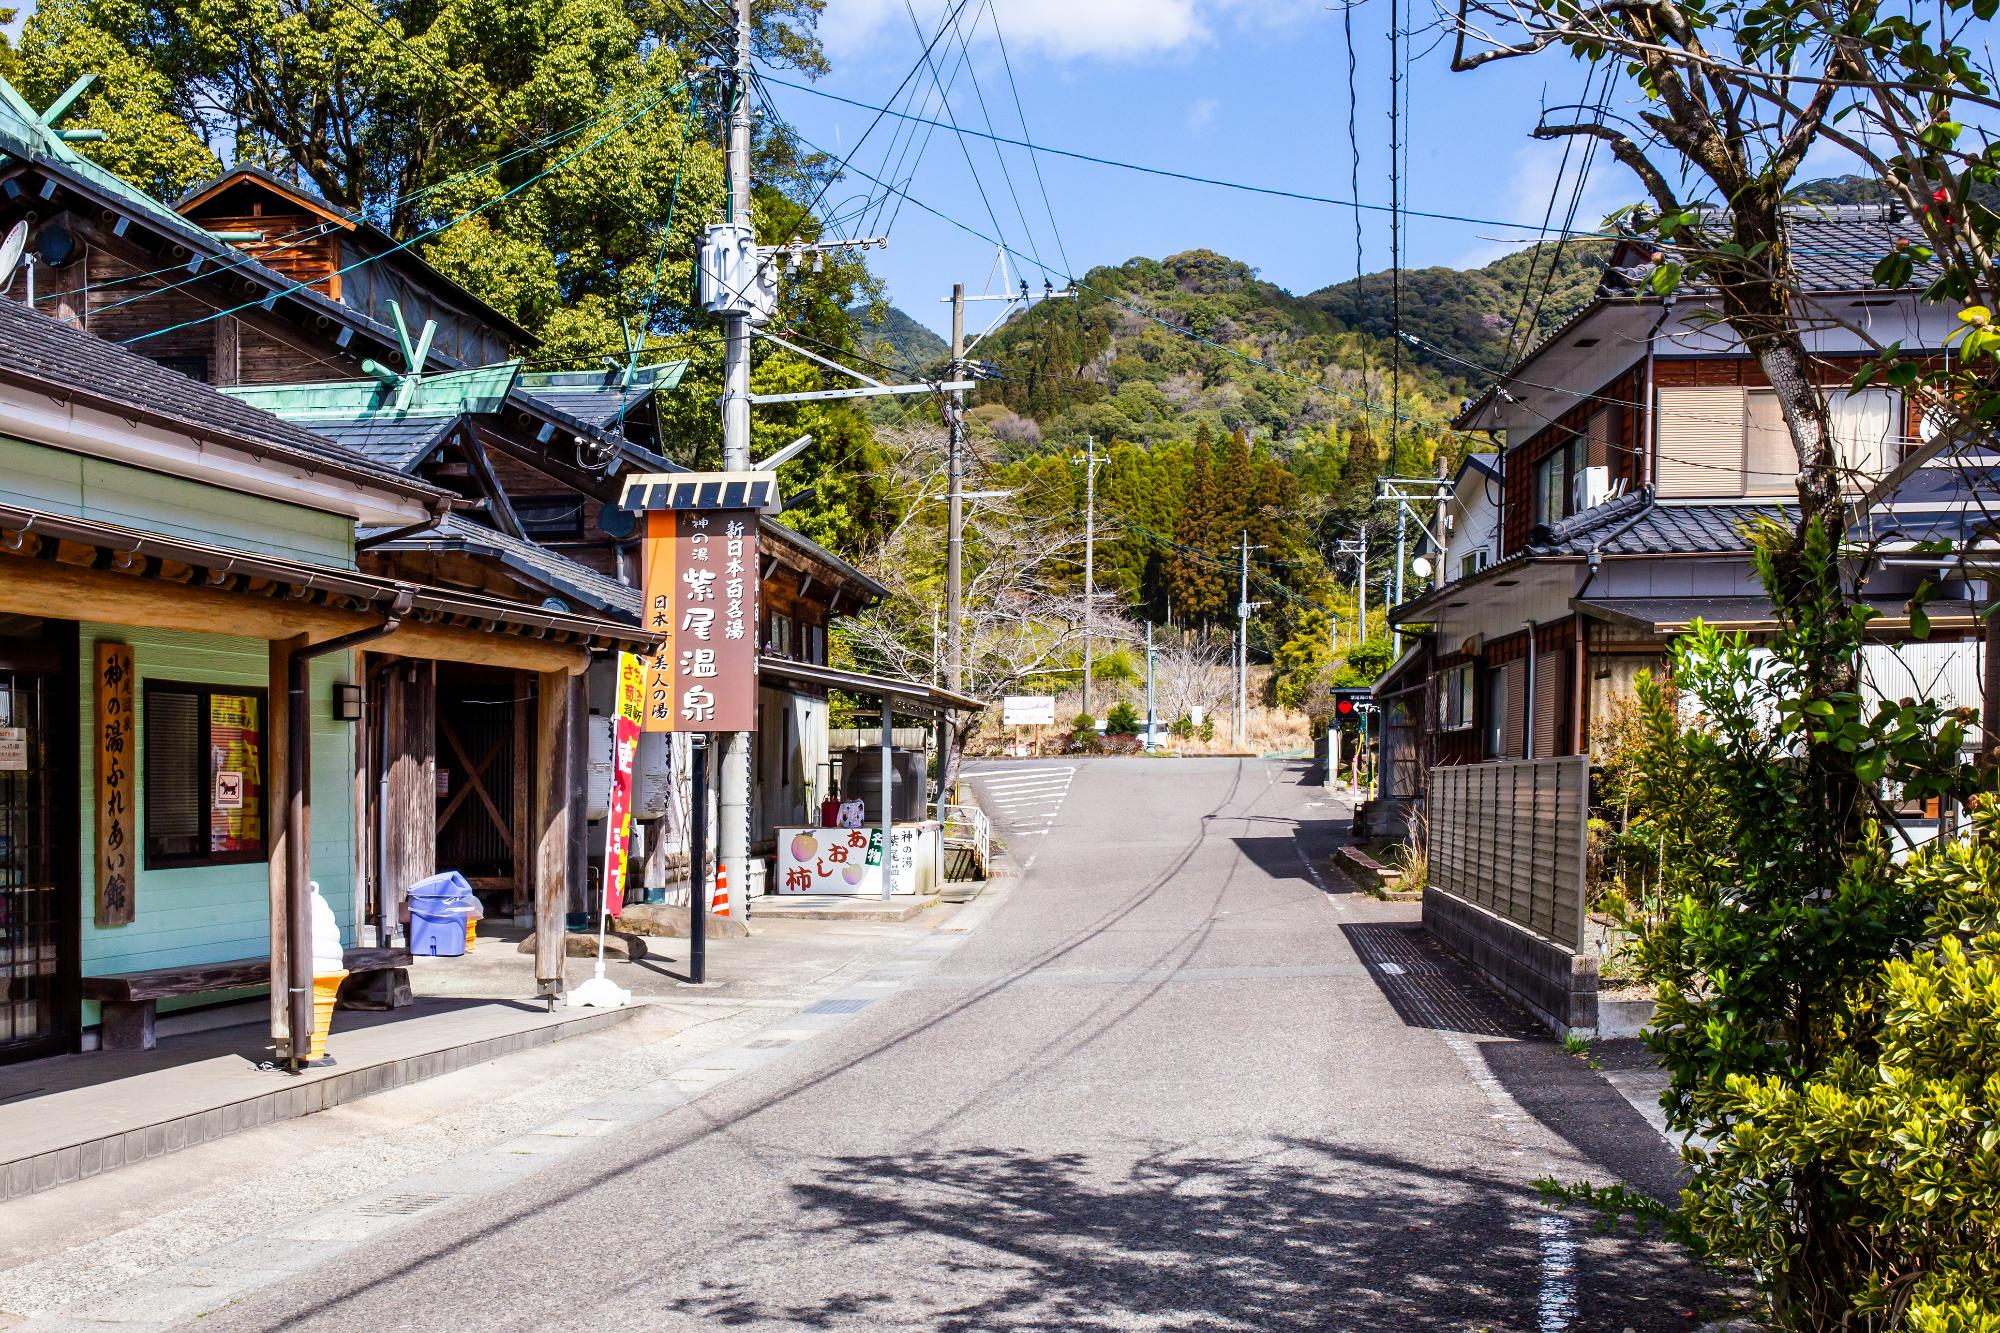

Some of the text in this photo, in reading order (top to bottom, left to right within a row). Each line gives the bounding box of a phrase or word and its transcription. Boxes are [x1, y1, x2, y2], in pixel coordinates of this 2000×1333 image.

[692, 518, 709, 562] 神の湯
[725, 520, 745, 639] 新日本百名湯
[682, 567, 718, 722] 紫尾温泉
[104, 653, 125, 912] 神の湯ふれあい館
[867, 832, 882, 864] 名物
[901, 830, 913, 869] 神の湯
